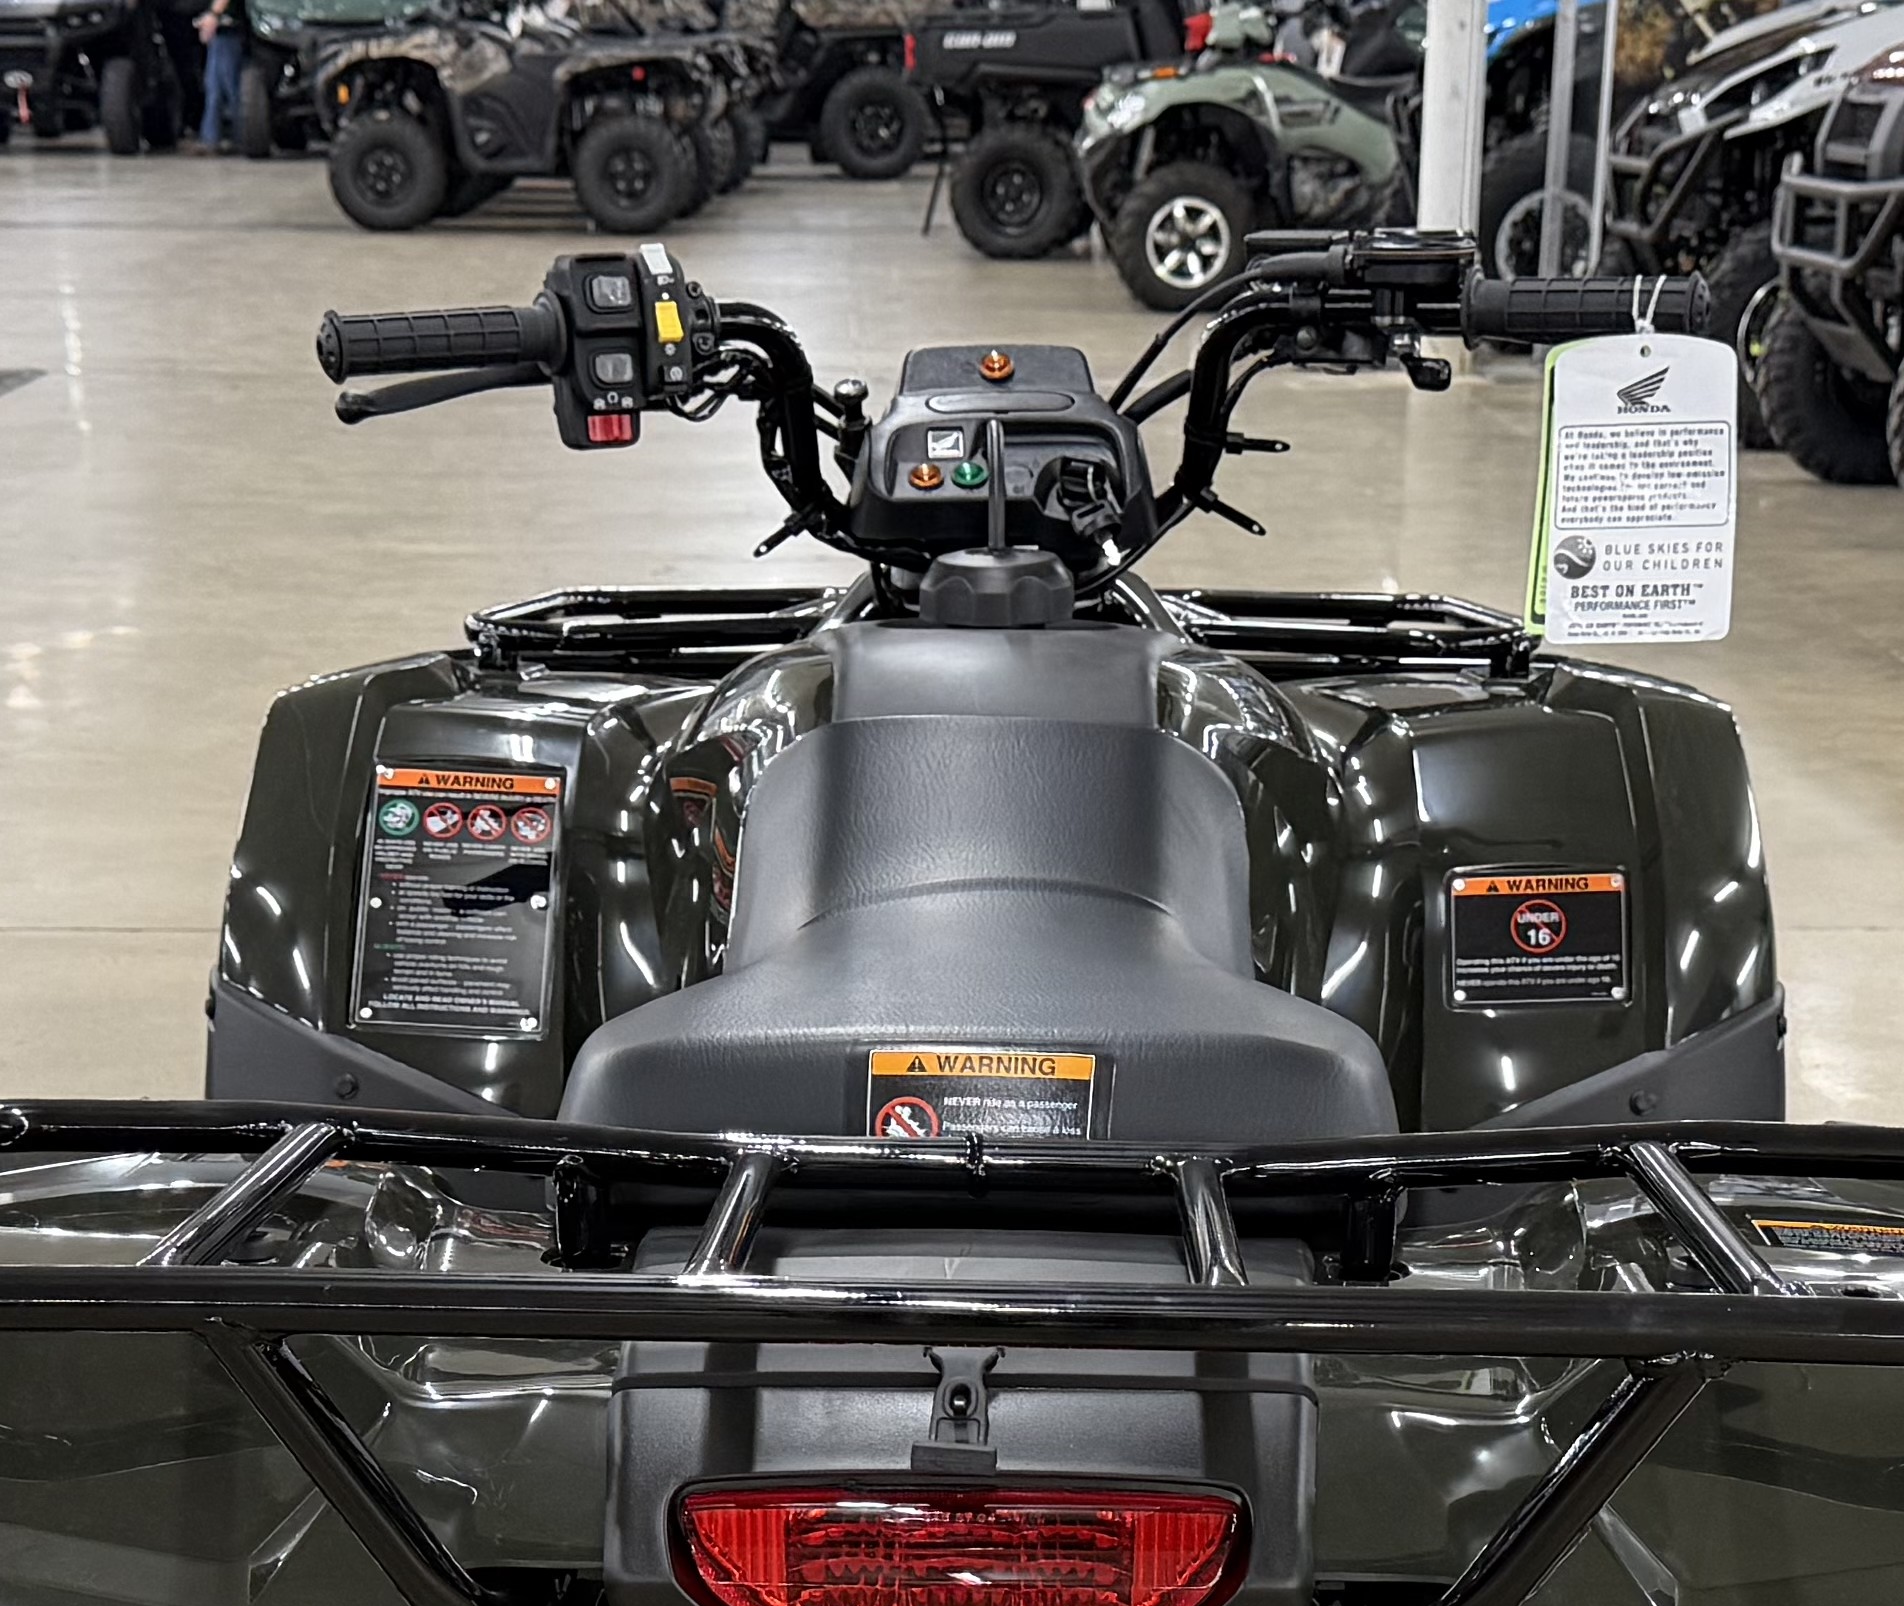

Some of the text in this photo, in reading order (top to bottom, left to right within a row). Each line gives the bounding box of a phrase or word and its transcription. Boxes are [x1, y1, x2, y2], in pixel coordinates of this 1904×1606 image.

[1617, 404, 1672, 414] HONDA
[1604, 542, 1723, 555] BLUE SKIES FOR
[1603, 558, 1723, 571] OUR CHILDREN
[1570, 585, 1610, 598] BEST
[1615, 584, 1635, 598] ON
[1574, 600, 1650, 612] PERFORMANCE
[436, 774, 514, 790] WARNING
[1507, 877, 1589, 891] WARNING
[1517, 911, 1560, 924] UNDER
[1527, 928, 1551, 946] 16
[936, 1055, 1056, 1077] WARNING
[943, 1096, 981, 1106] NEVER
[1026, 1100, 1078, 1112] passenger
